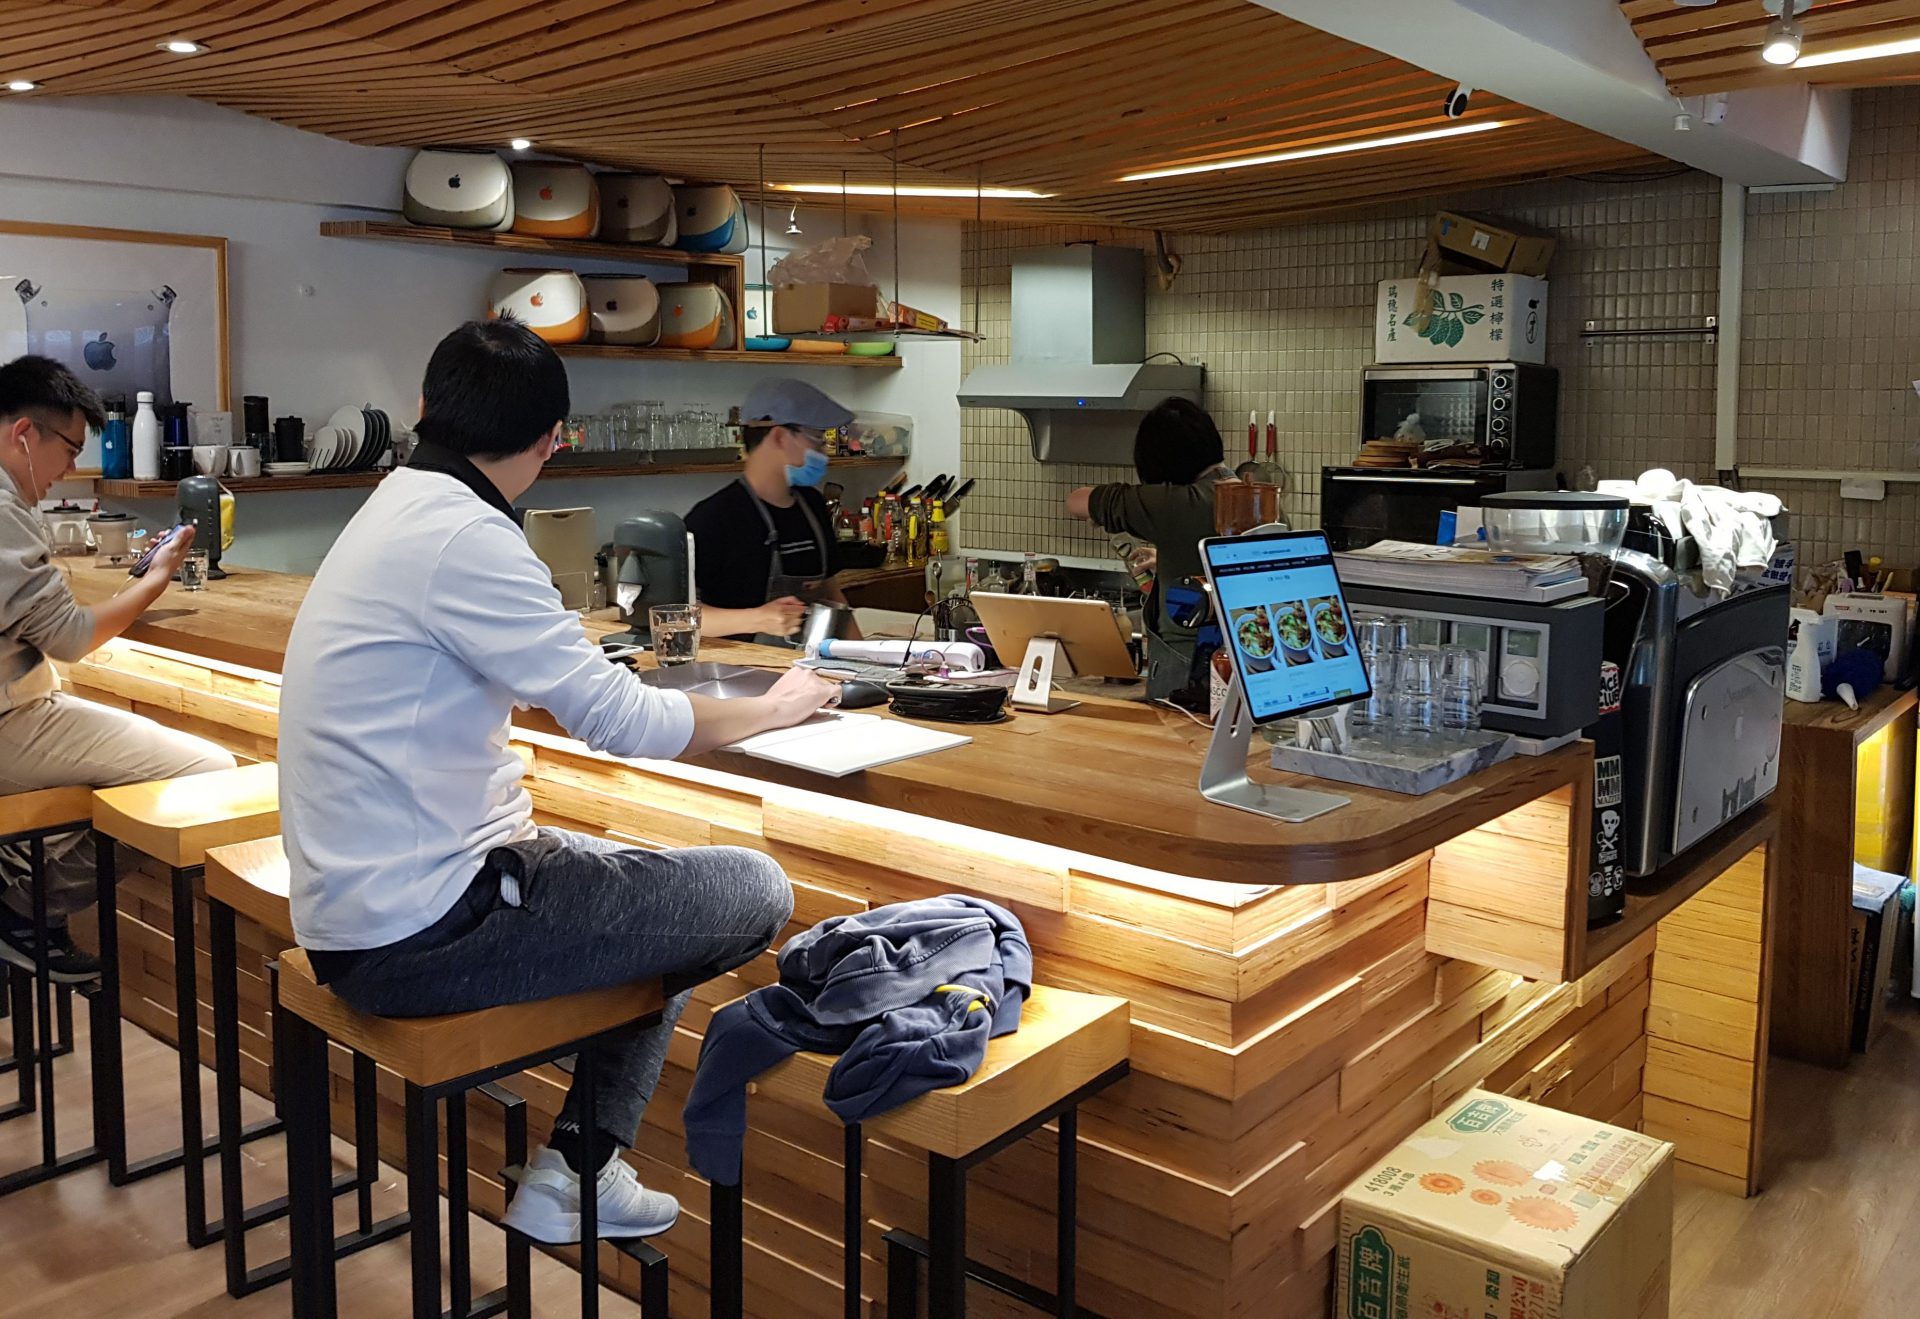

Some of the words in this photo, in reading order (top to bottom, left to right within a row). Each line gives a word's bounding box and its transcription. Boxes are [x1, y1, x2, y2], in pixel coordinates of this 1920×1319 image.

[1489, 278, 1505, 341] 特選檸檬
[1364, 1166, 1402, 1192] 418008
[1358, 1246, 1383, 1319] 百吉牌
